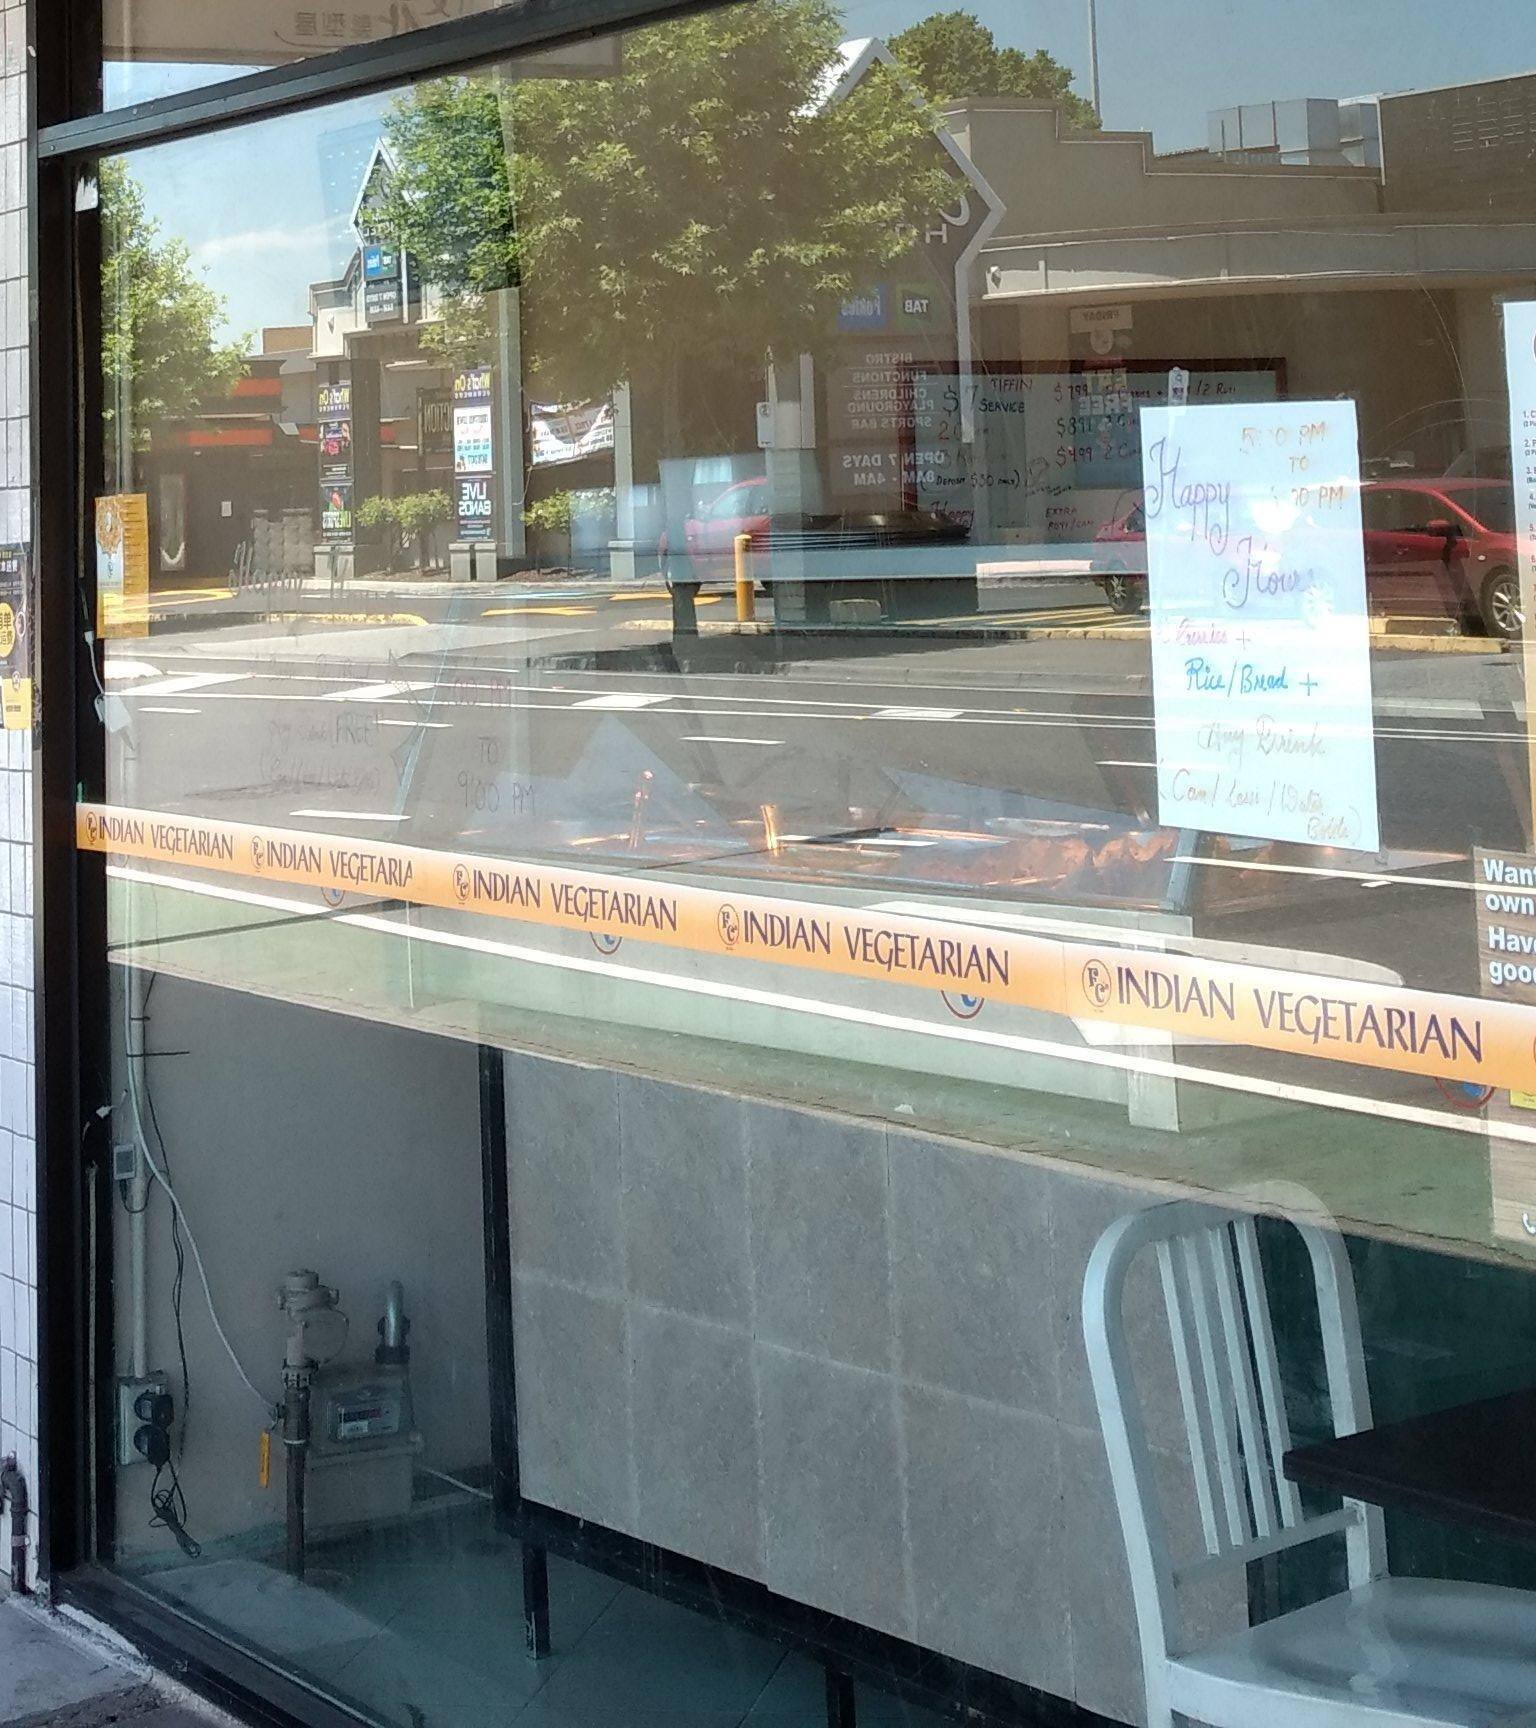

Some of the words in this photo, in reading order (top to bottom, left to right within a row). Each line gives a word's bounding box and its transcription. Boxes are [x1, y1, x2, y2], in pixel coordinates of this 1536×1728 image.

[978, 400, 1026, 413] SERVICE
[99, 816, 145, 847] INDIAN
[151, 824, 234, 861] VEGETARIAN
[267, 840, 322, 874] INDIAN
[473, 869, 541, 909] INDIAN
[551, 883, 678, 932] VEGETARIAN
[1485, 893, 1536, 916] own
[742, 909, 832, 955] INDIAN
[843, 926, 1010, 986] VEGETARIAN
[1117, 966, 1235, 1022] INDIAN
[1252, 986, 1482, 1065] VEGETARIAN
